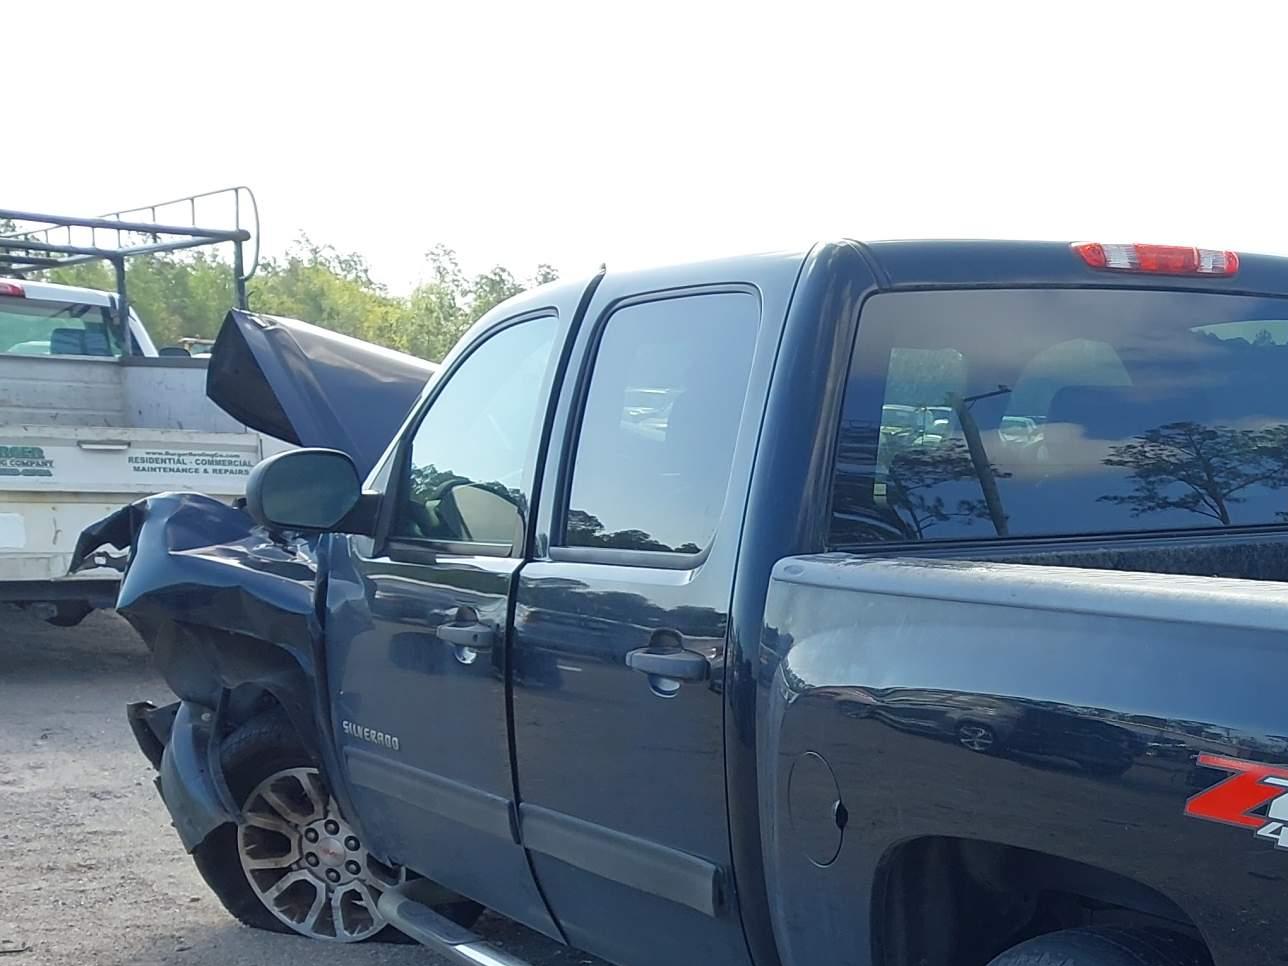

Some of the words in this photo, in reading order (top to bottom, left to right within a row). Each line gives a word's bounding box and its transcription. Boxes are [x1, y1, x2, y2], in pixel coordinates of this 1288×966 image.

[128, 456, 187, 465] RESIDENTIAL
[195, 458, 255, 467] COMMERCIAL
[342, 720, 399, 750] SILVERADO
